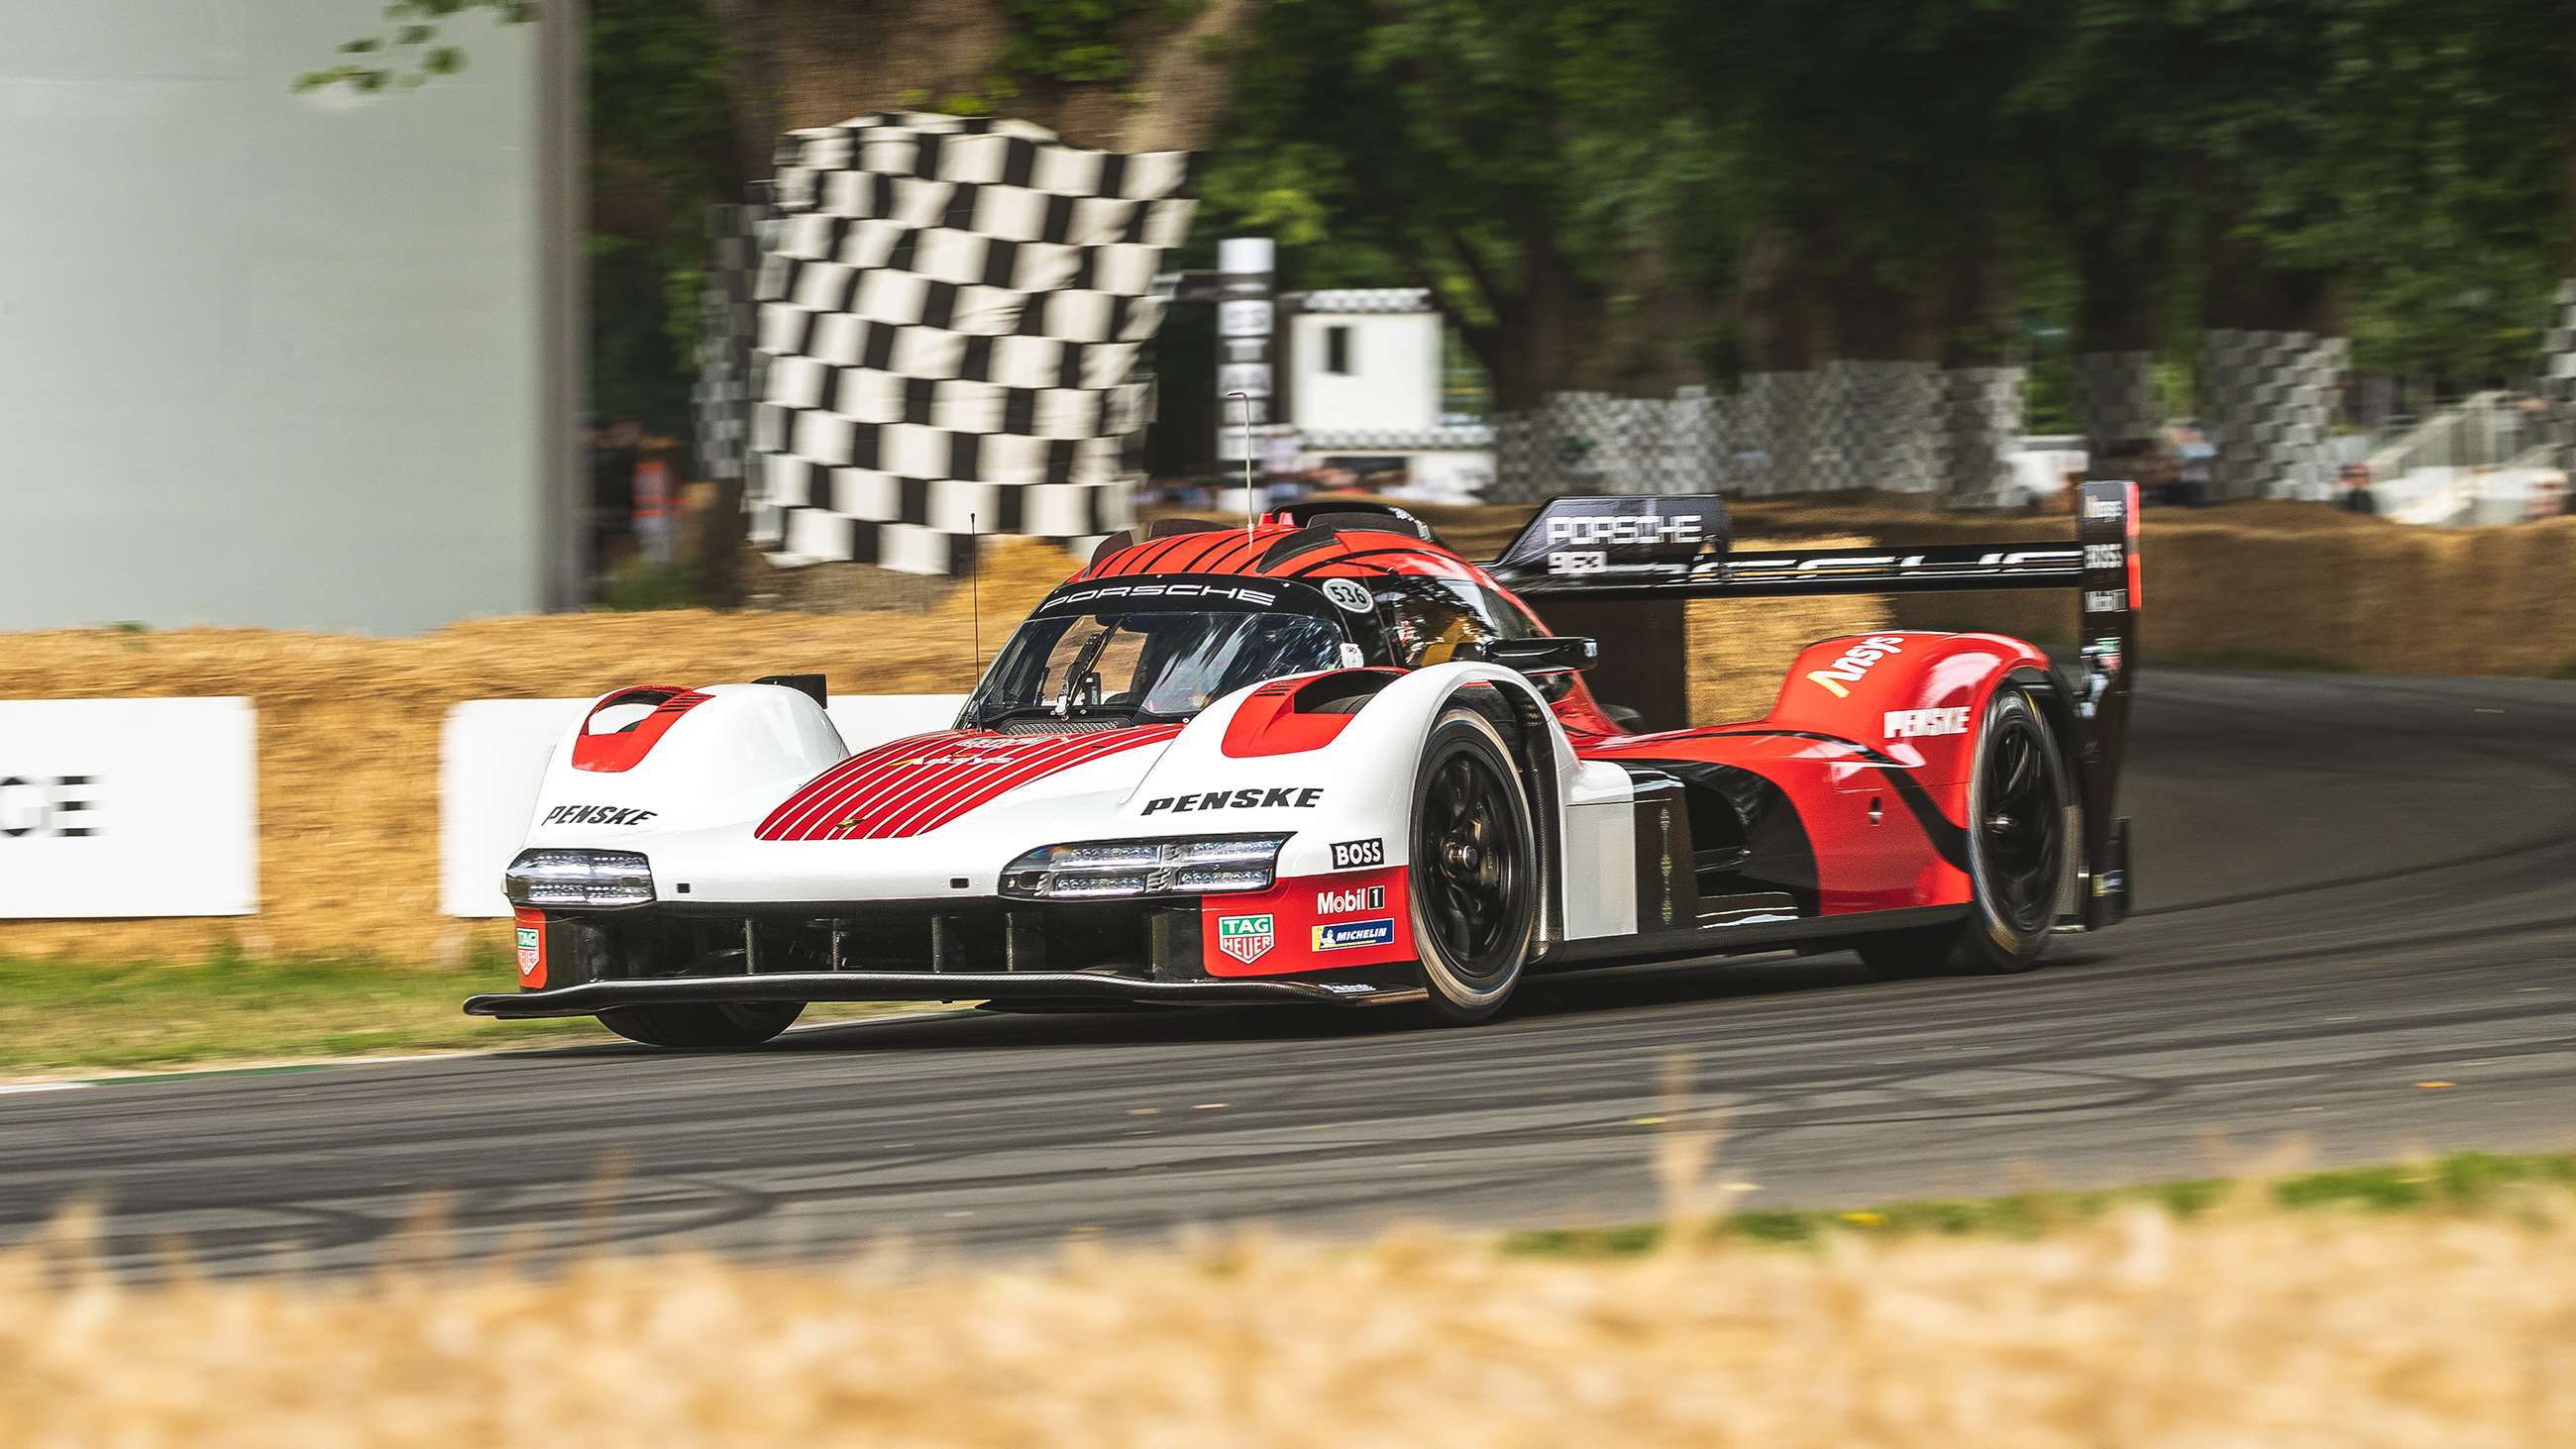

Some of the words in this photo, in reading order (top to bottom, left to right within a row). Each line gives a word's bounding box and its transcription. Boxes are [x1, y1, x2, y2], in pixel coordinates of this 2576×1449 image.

[1547, 514, 1703, 545] PORSCHE
[1039, 584, 1276, 613] PORSCHE
[1331, 584, 1367, 606] 536
[1806, 636, 1905, 698] Ansys
[1140, 787, 1325, 816] PENSKE
[542, 804, 658, 826] PENSKE
[1336, 841, 1382, 867] BOSS
[1317, 888, 1366, 915] Mobil
[1224, 919, 1269, 934] TAG
[1336, 927, 1388, 942] MICHELIN
[1222, 936, 1272, 960] HEUER
